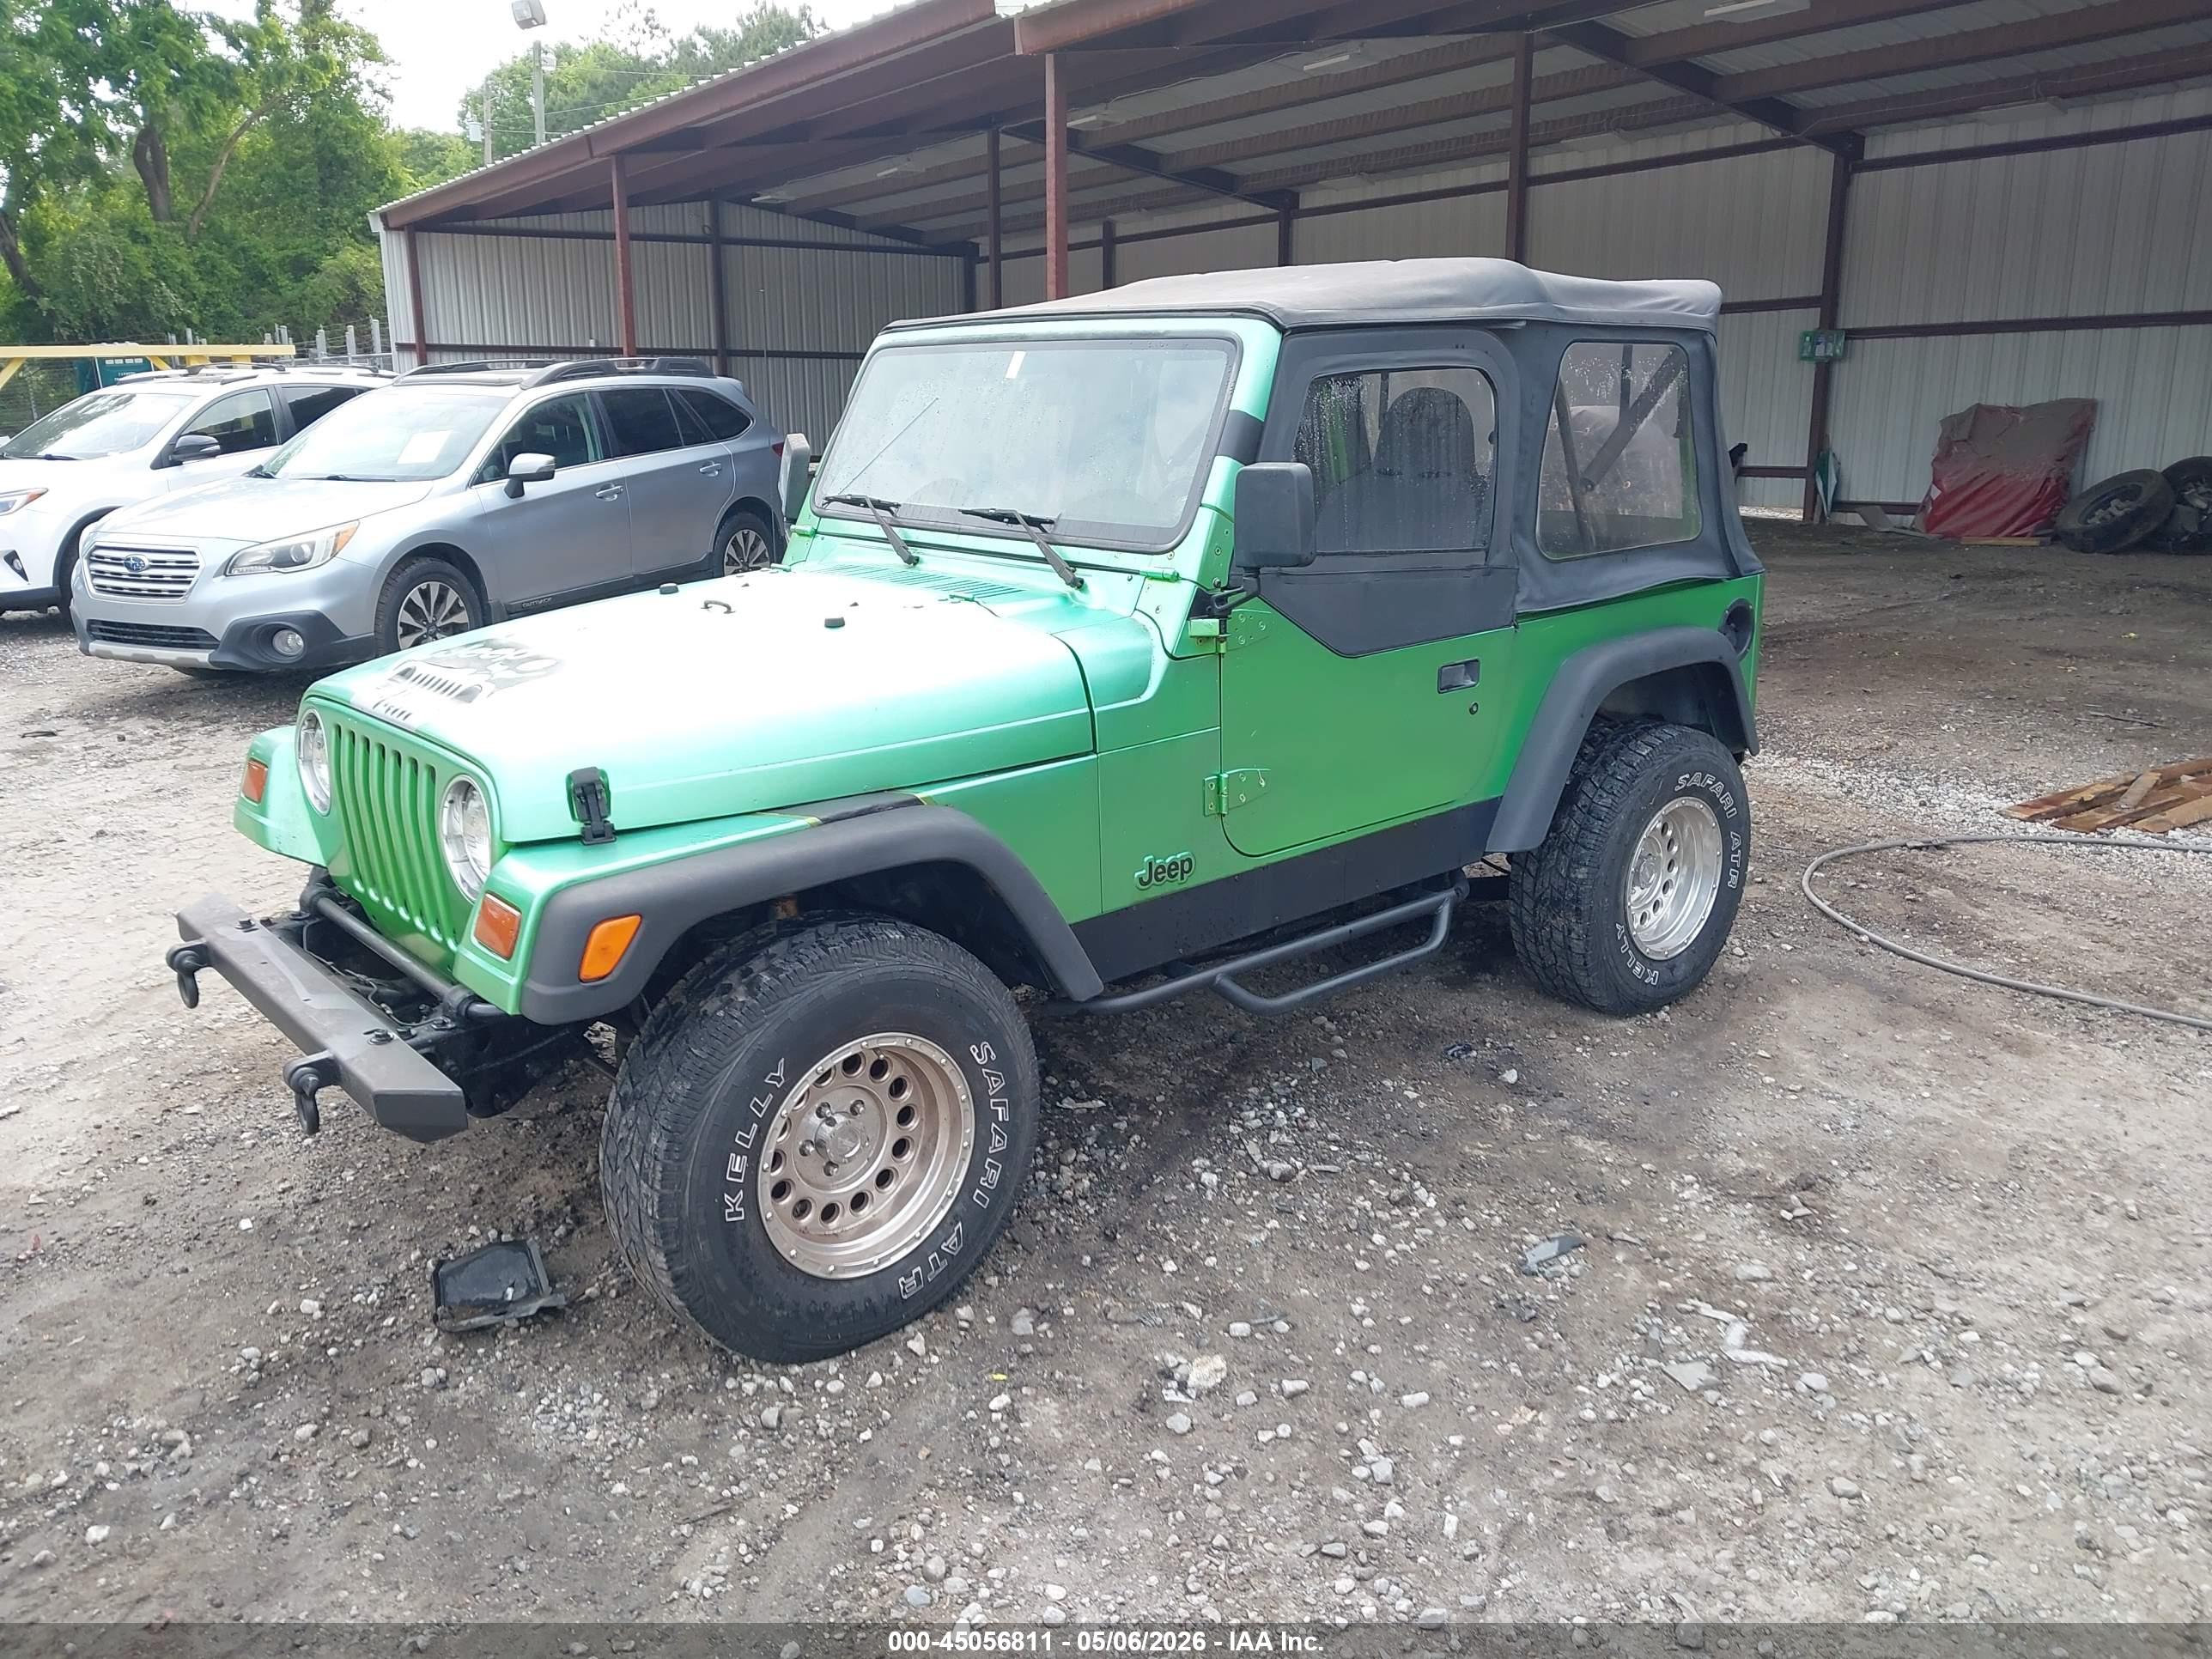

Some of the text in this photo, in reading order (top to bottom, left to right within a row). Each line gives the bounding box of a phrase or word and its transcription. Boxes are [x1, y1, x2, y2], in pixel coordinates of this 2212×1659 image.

[1134, 851, 1195, 890] Jeep
[1674, 772, 1741, 889] SAFARI ATR
[1615, 922, 1659, 985] KELLY
[724, 1057, 785, 1222] KELLY
[899, 1042, 1009, 1300] SAFARI ATR
